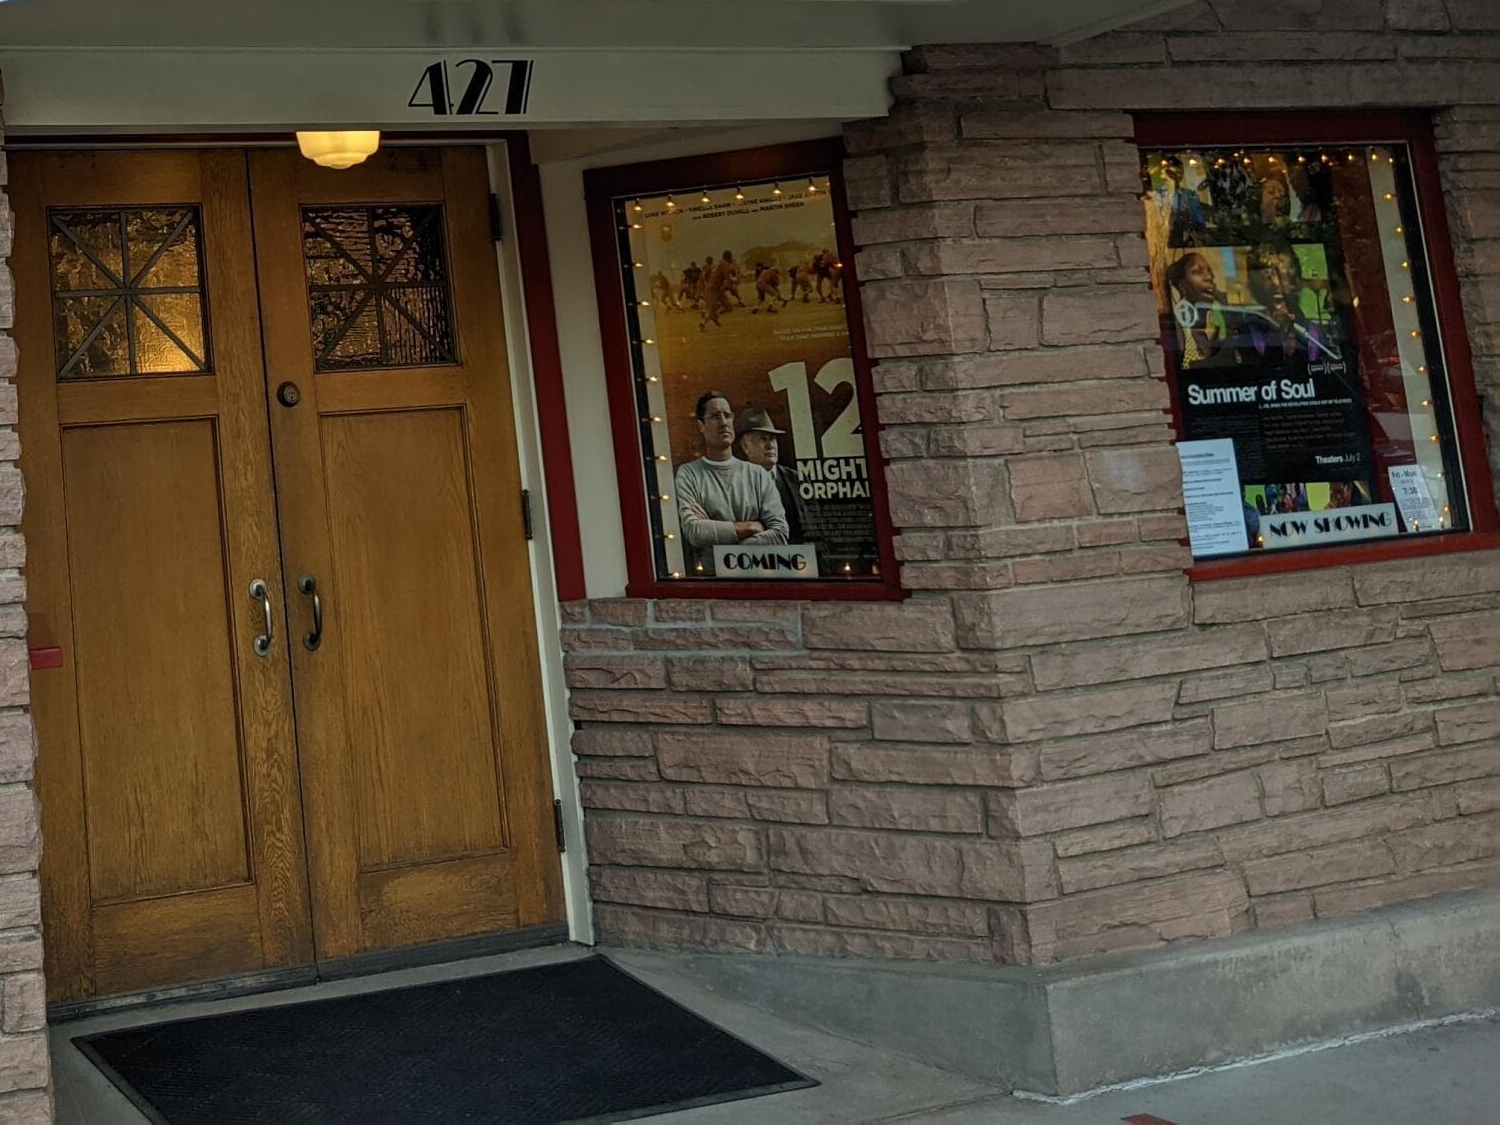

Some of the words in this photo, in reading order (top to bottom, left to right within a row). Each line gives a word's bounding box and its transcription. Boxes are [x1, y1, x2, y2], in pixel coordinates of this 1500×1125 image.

[407, 58, 534, 115] 427
[1188, 384, 1258, 405] Summer
[1261, 380, 1276, 400] of
[1281, 377, 1315, 399] Soul
[768, 357, 865, 459] 12
[1269, 519, 1308, 539] NOW
[1314, 512, 1392, 534] SHOWING
[723, 553, 806, 570] COMING
